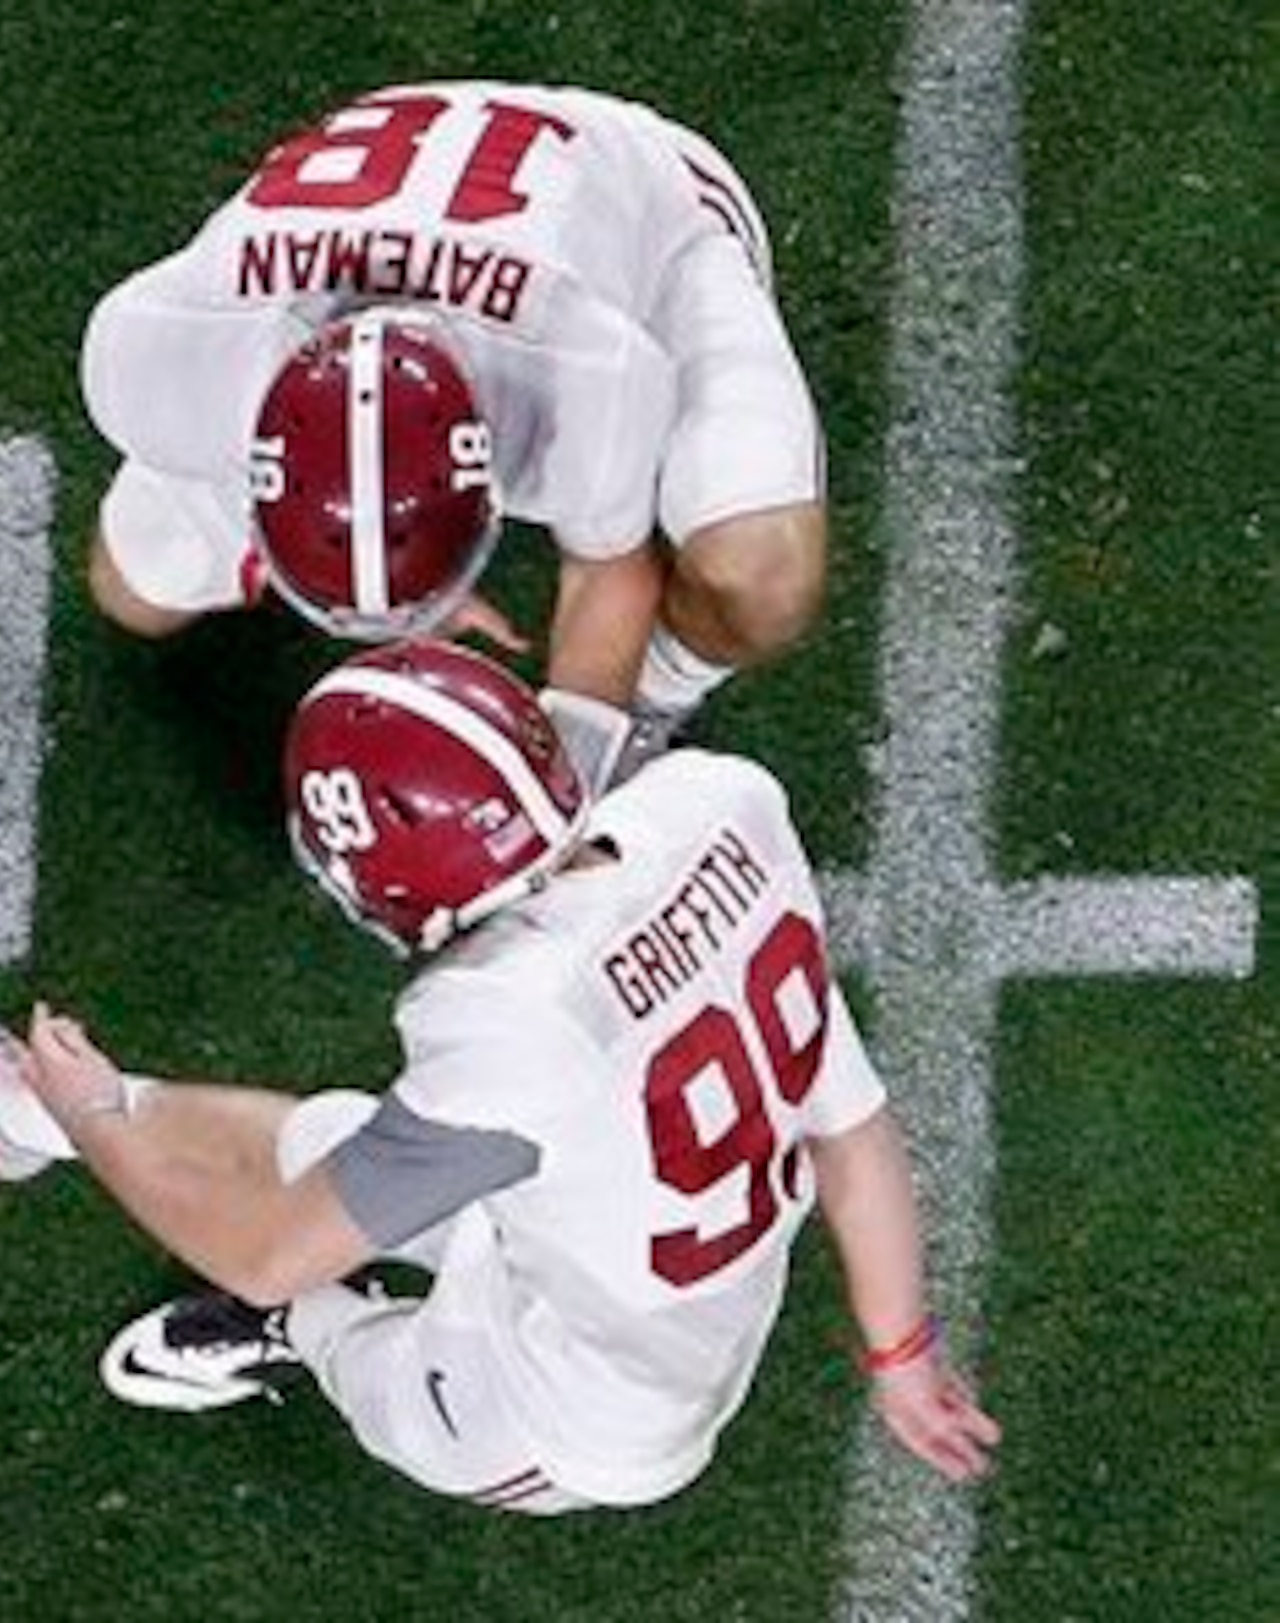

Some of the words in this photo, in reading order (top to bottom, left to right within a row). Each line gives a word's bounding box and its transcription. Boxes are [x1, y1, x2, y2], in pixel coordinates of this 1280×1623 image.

[244, 95, 575, 223] 18
[238, 230, 532, 322] BATEMAN
[448, 421, 492, 491] 18
[302, 769, 377, 851] 99
[603, 828, 769, 1020] GRIFFITH
